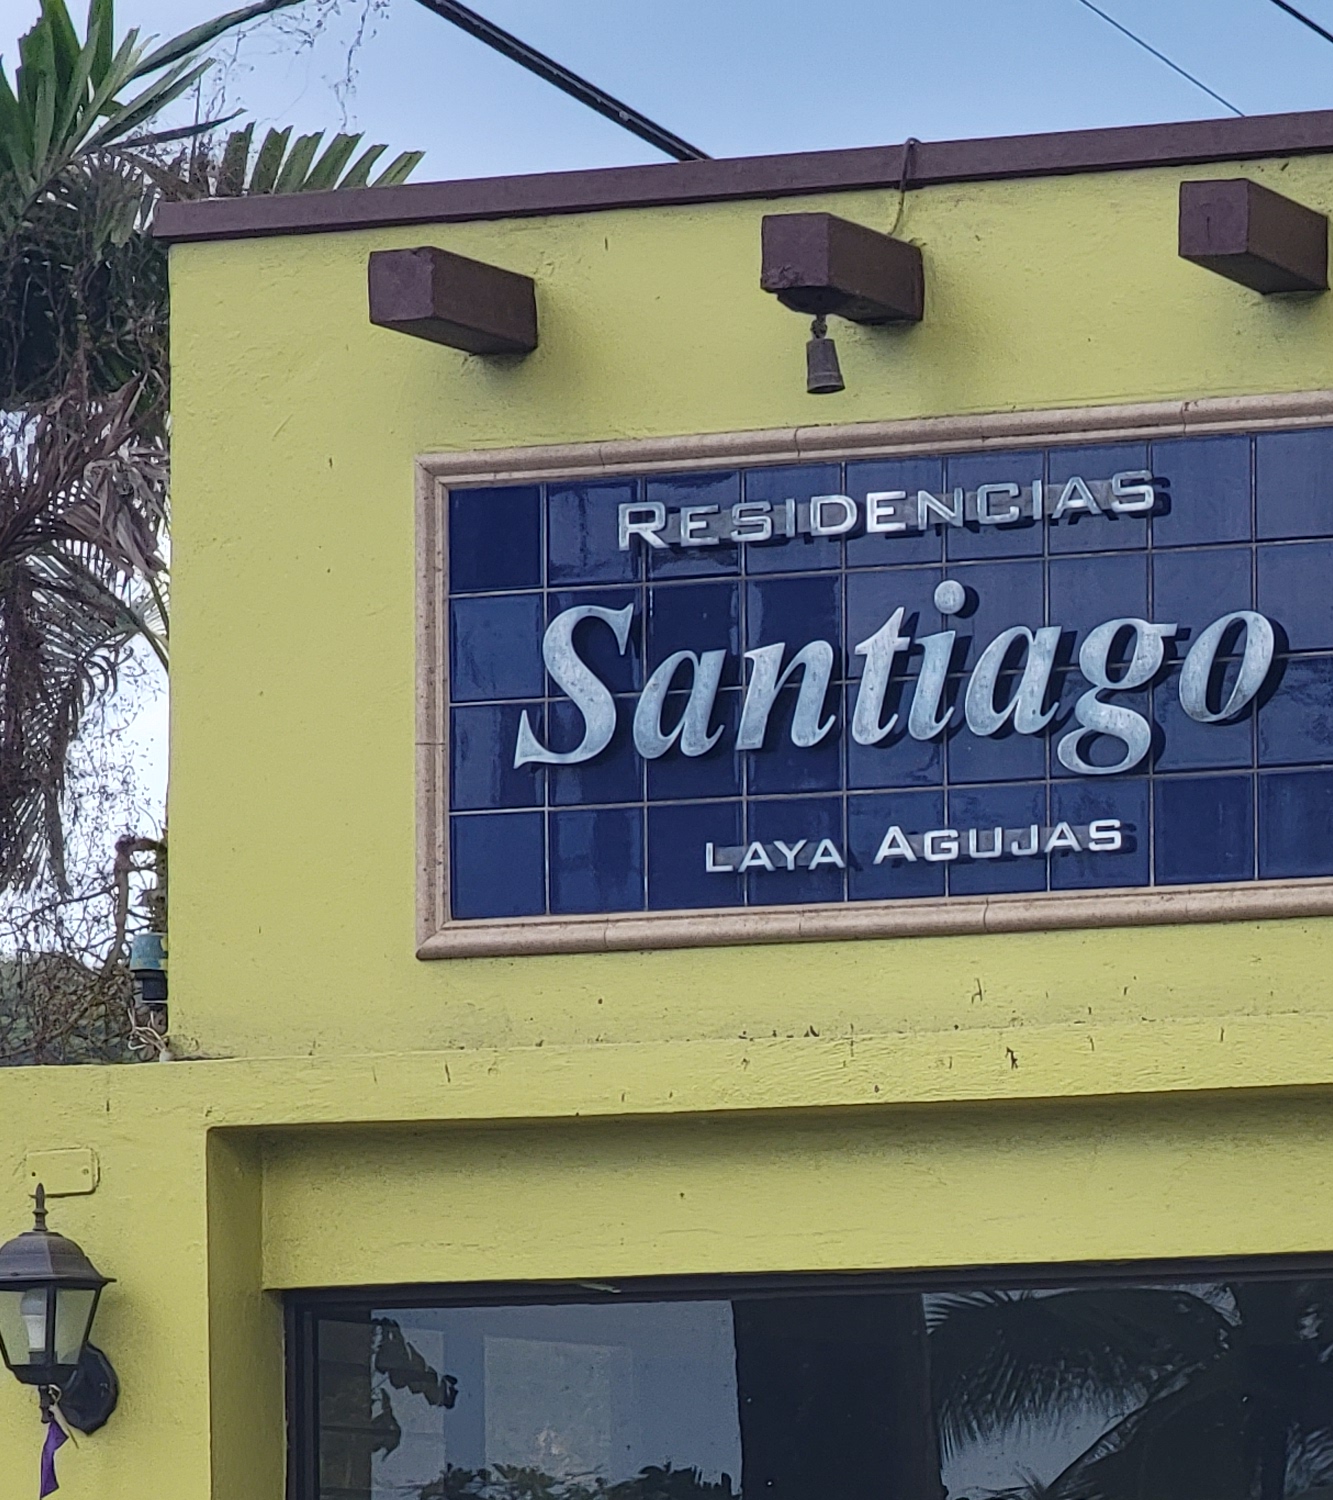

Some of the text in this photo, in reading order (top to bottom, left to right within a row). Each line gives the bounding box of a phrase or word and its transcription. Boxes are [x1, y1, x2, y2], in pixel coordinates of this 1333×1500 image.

[618, 469, 1154, 551] RESIDENCIAS
[513, 579, 1276, 774] Santiago
[704, 818, 1123, 874] LAYA AGUJAS
